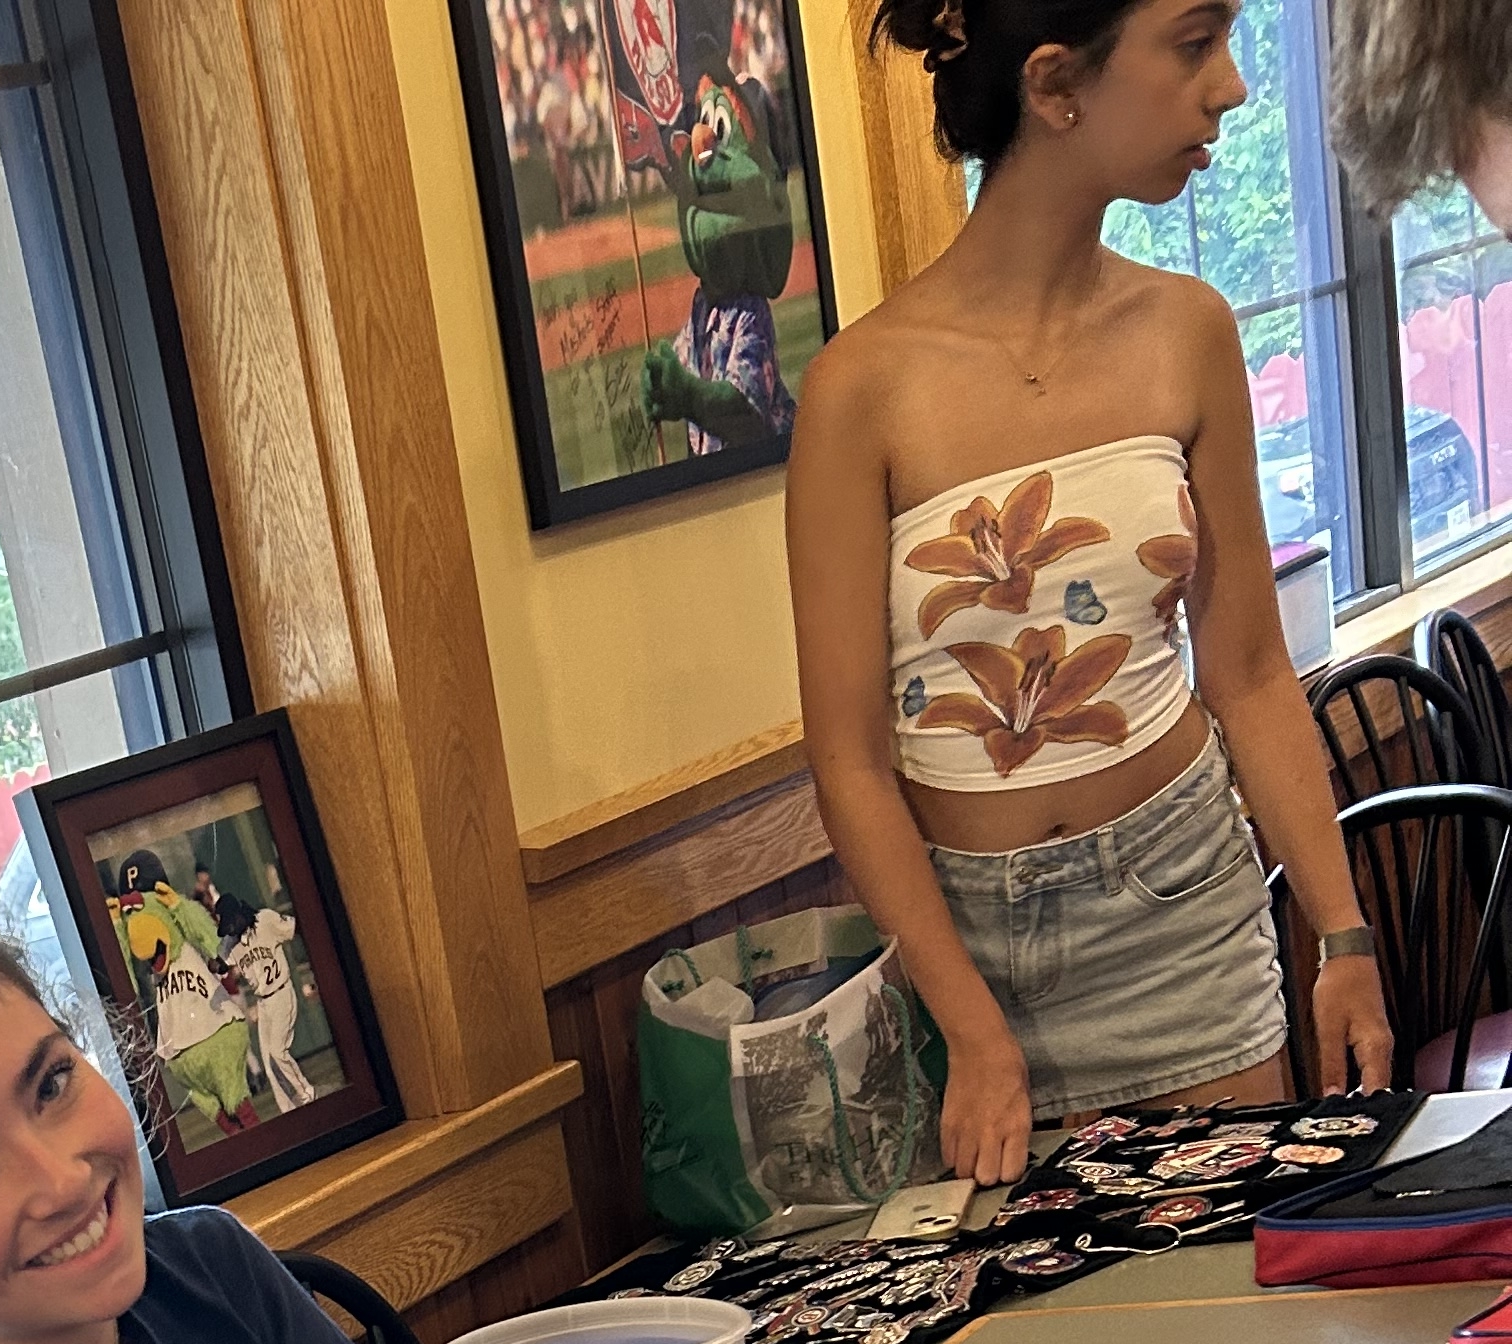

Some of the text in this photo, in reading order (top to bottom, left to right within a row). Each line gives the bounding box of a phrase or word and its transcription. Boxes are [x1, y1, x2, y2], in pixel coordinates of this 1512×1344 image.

[128, 865, 139, 889] P
[239, 946, 275, 972] PIRATES
[263, 959, 282, 986] 22
